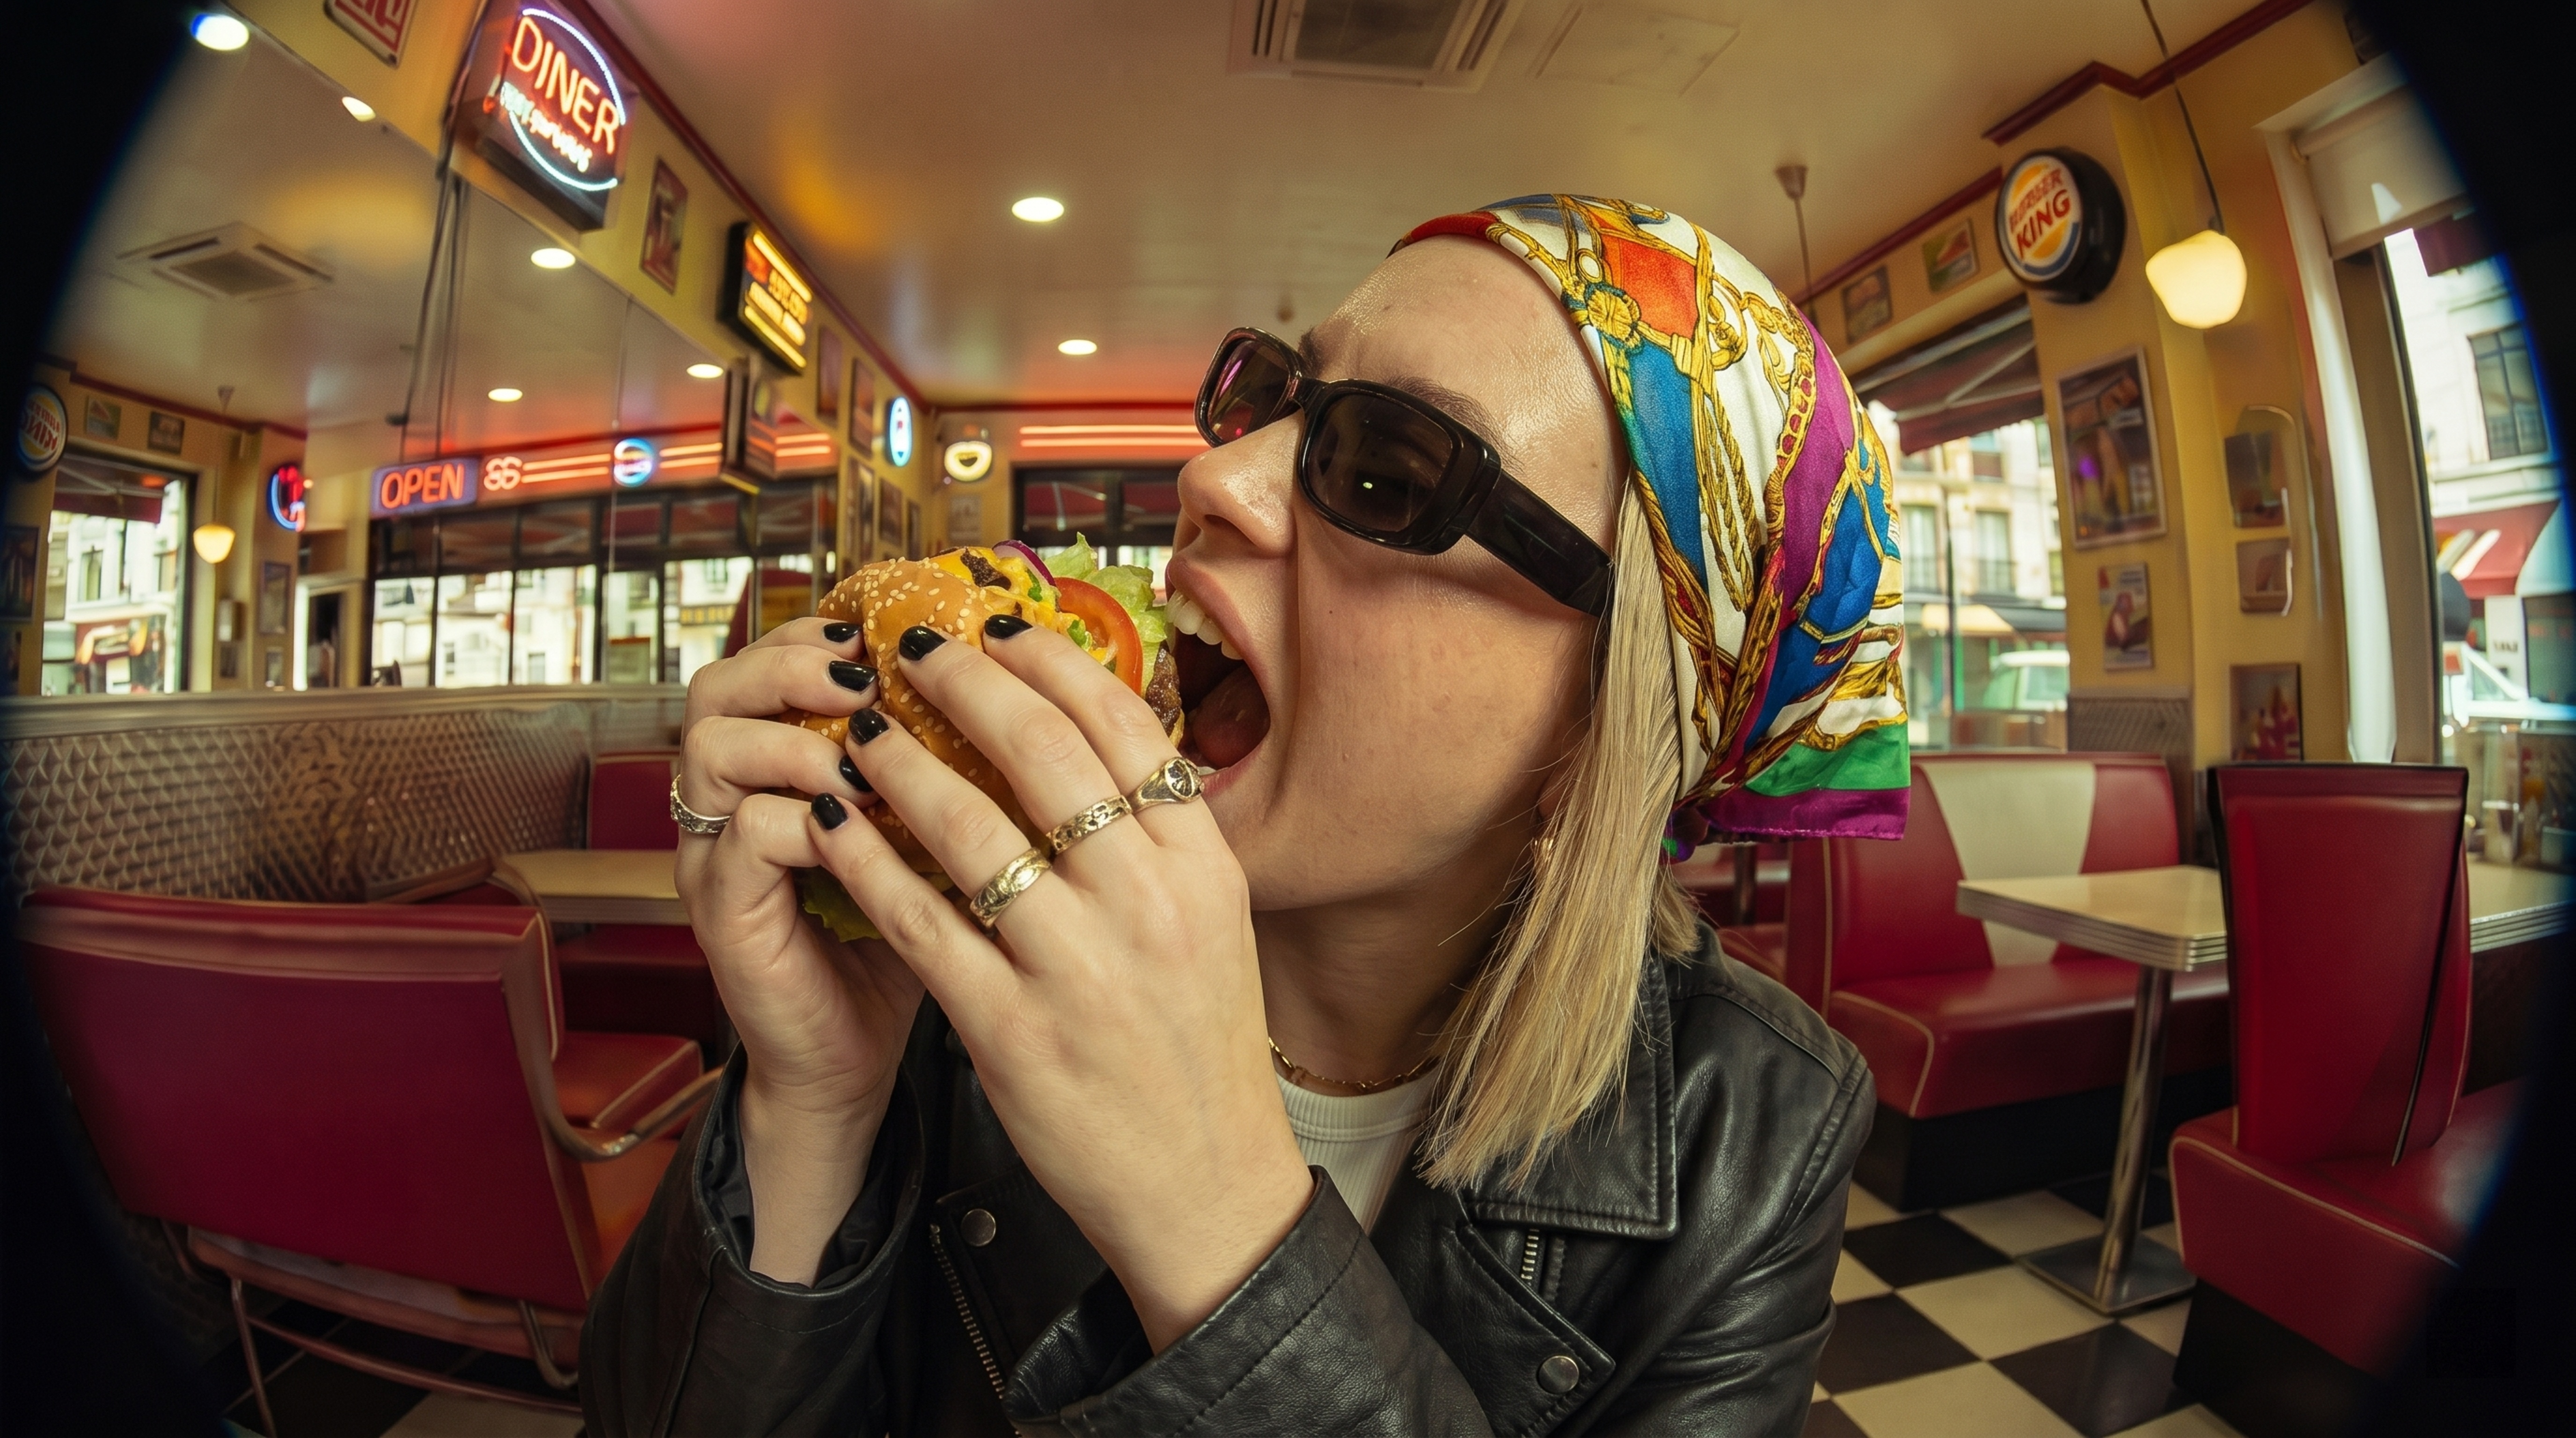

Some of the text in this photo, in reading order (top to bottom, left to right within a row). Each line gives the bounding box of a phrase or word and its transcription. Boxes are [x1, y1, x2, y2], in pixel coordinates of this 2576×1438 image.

[512, 16, 620, 154] DINER
[2016, 188, 2071, 260] KING
[381, 462, 465, 509] OPEN
